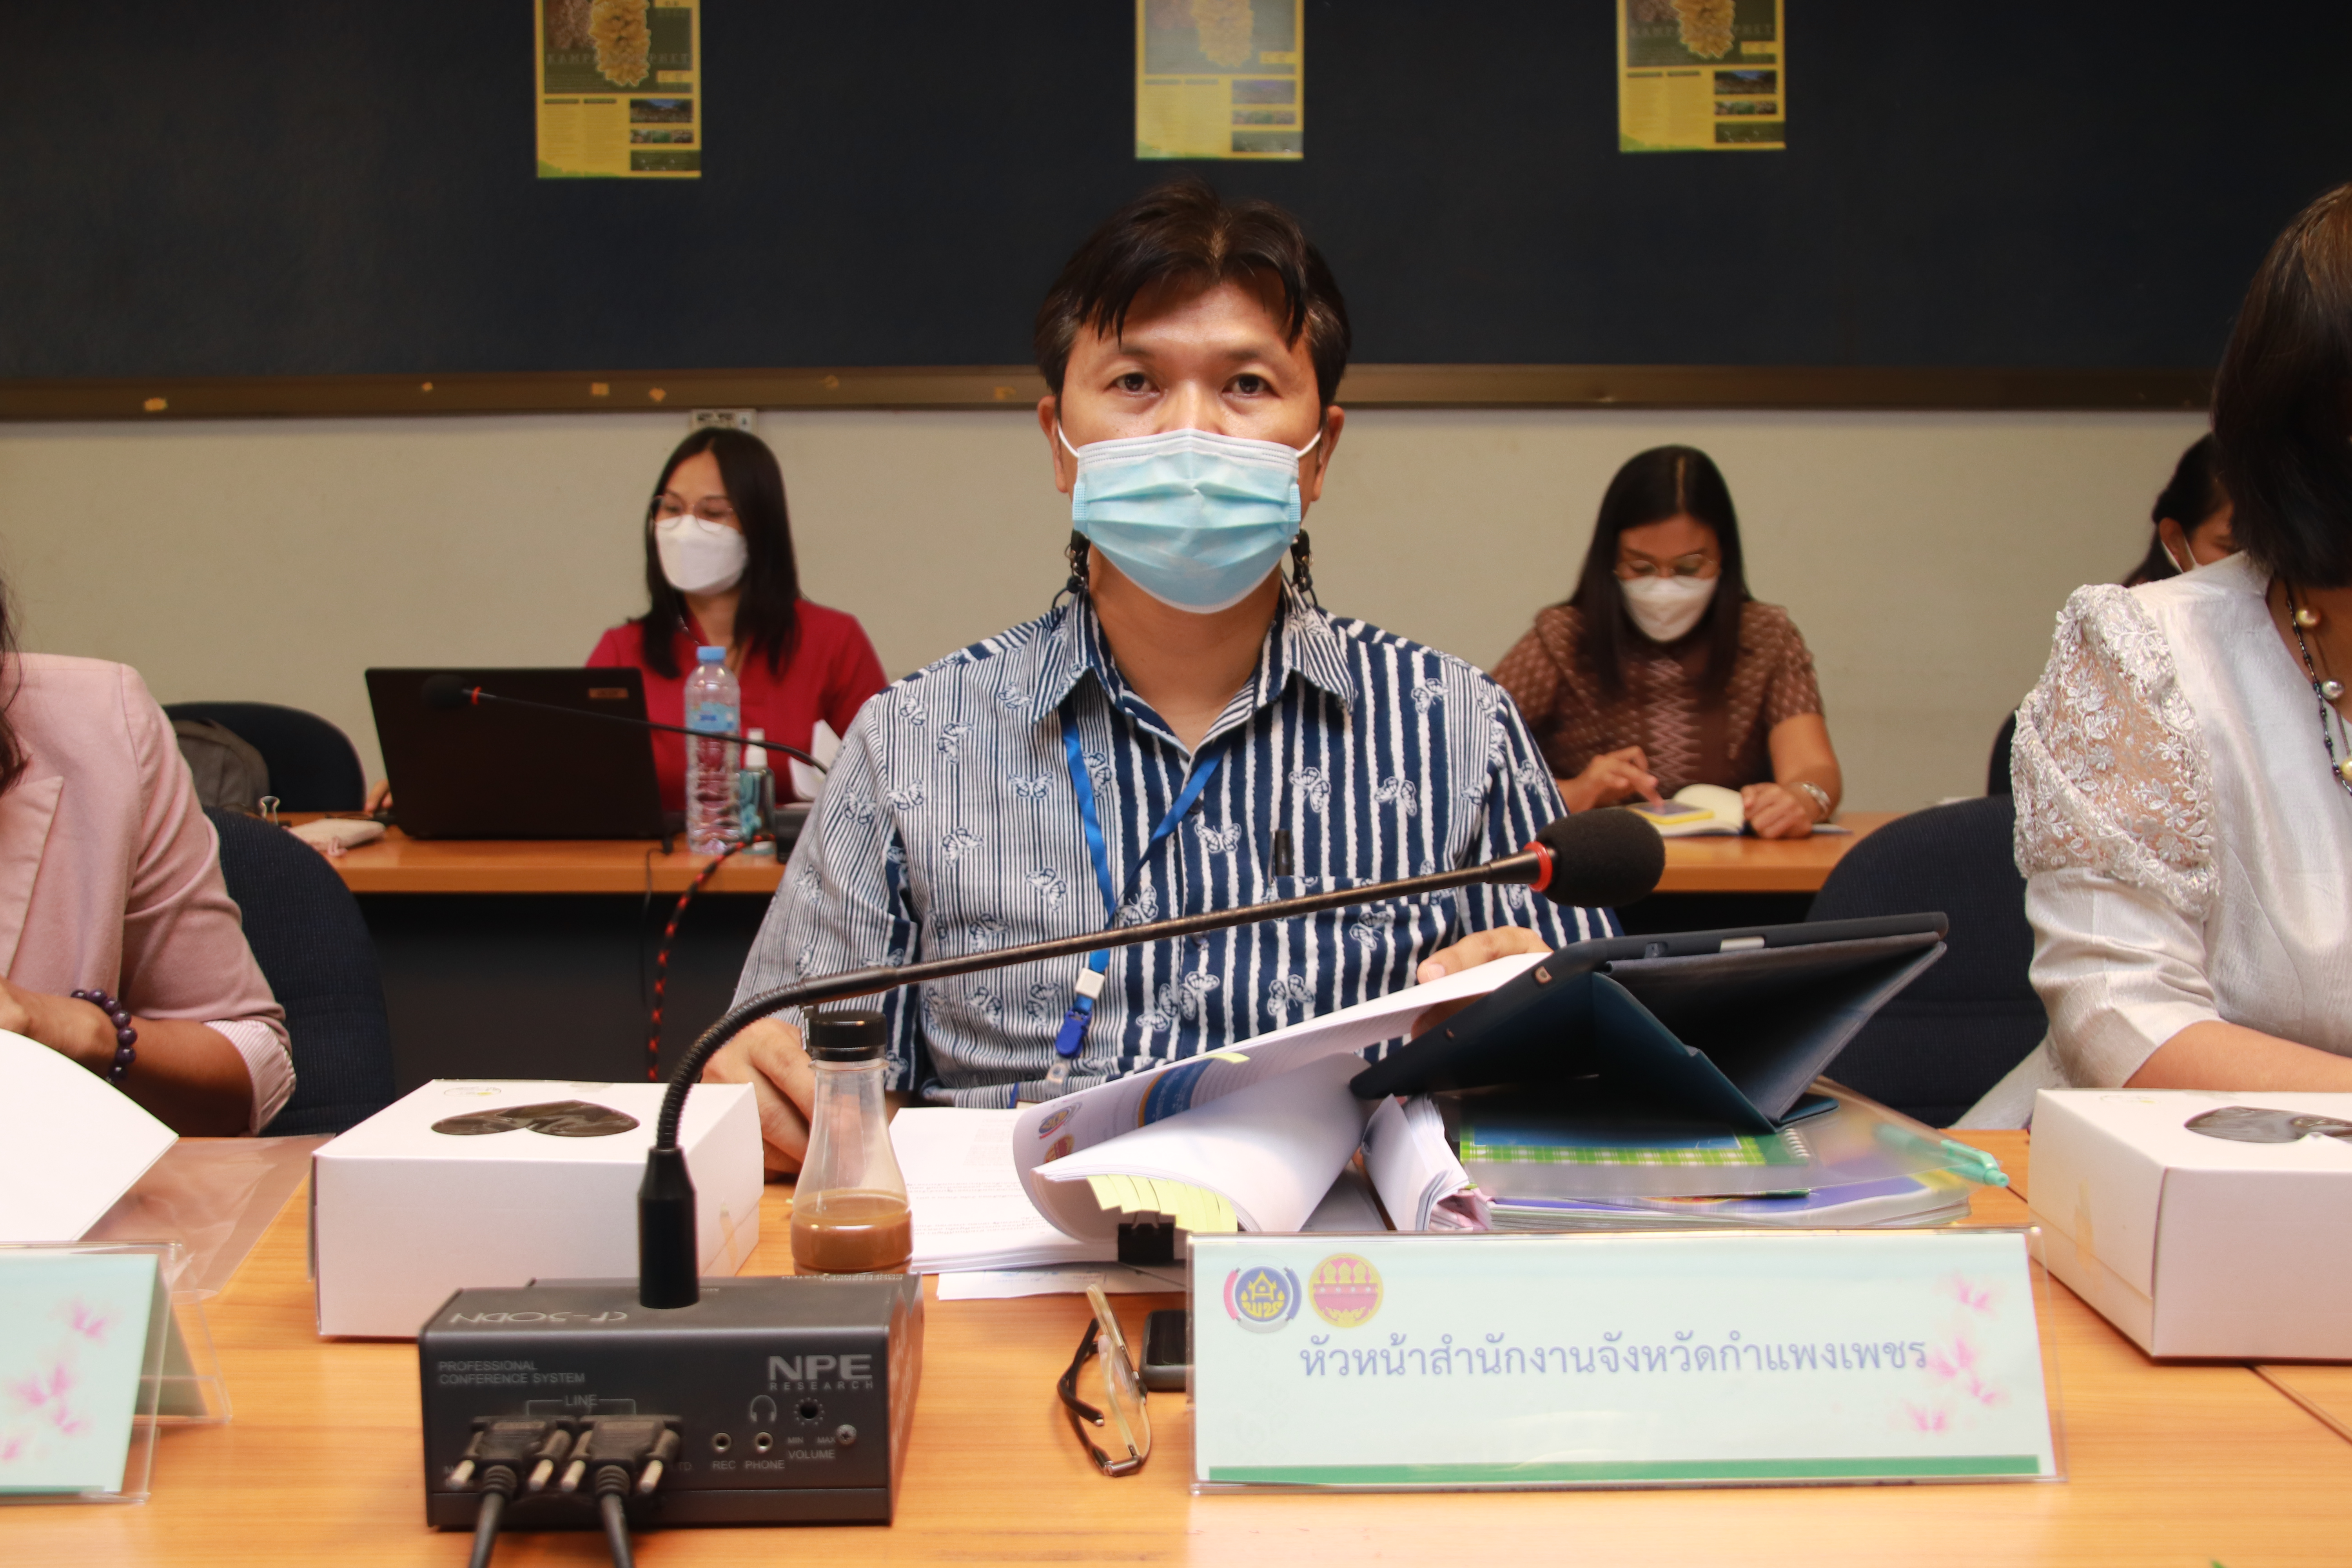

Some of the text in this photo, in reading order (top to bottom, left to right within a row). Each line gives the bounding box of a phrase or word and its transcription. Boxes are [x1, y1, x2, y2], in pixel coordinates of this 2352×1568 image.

[1299, 1329, 1927, 1376] หัวหน้าสำนักงานจังหวัดกำแพงเพชร
[438, 1361, 538, 1371] PROFESSIONAL
[769, 1354, 873, 1380] NPE
[439, 1372, 585, 1384] CONFERENCE SYSTEM
[769, 1381, 873, 1390] RESEARCH
[565, 1394, 598, 1406] LINE
[788, 1449, 835, 1459] VOLUME
[712, 1460, 735, 1470] REC
[745, 1459, 785, 1469] PHONE
